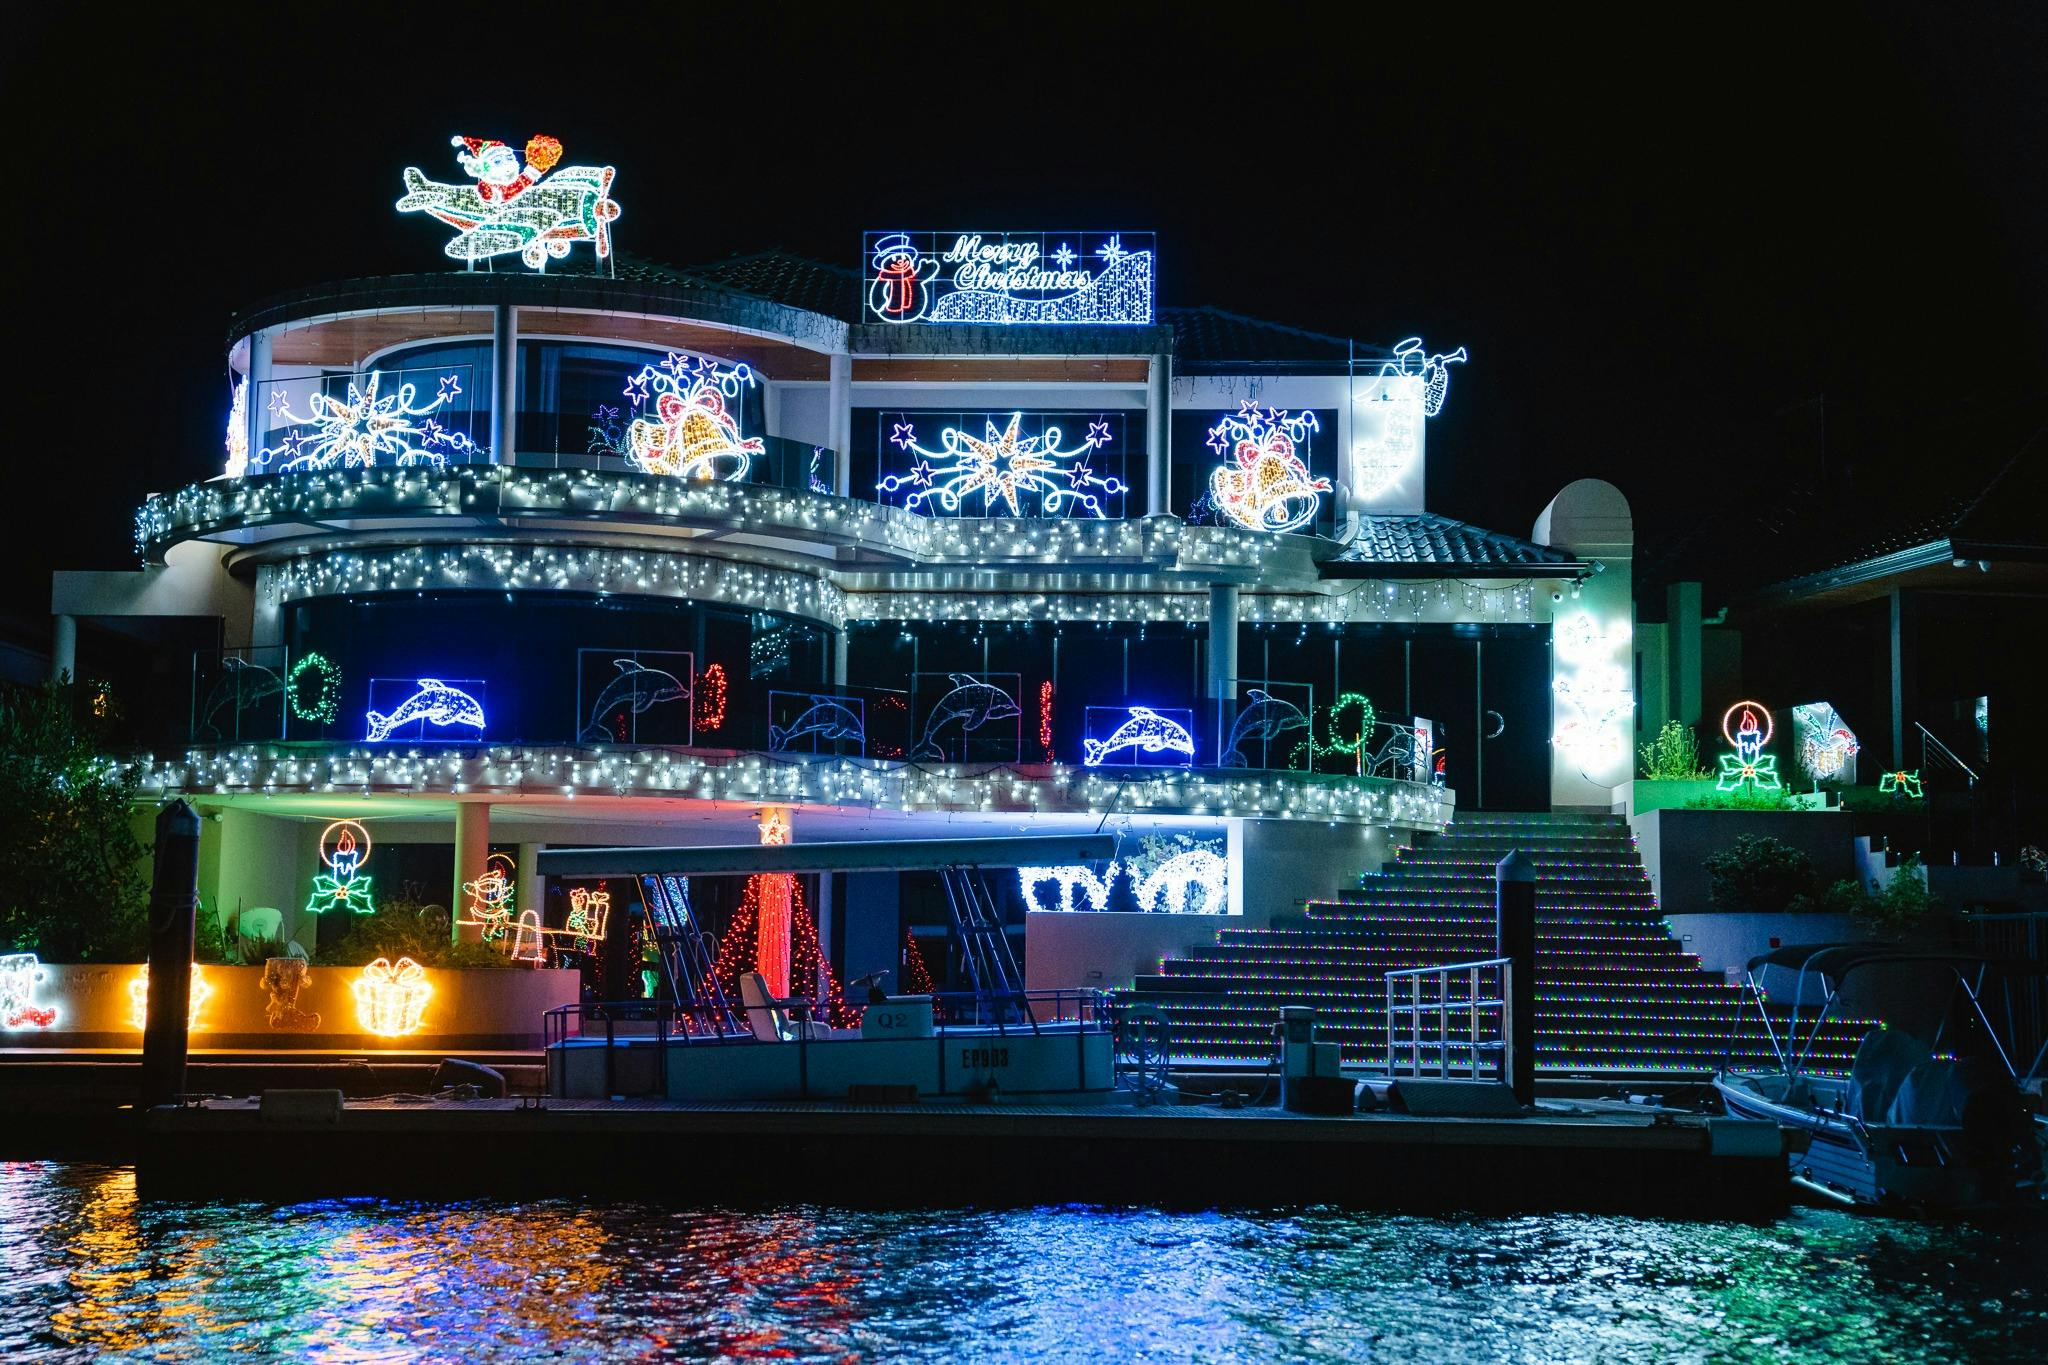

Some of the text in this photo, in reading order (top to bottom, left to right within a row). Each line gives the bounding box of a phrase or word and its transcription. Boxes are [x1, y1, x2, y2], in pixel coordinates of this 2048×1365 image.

[943, 235, 1039, 269] Merry
[954, 262, 1090, 290] Christmas
[878, 1013, 908, 1029] Q2
